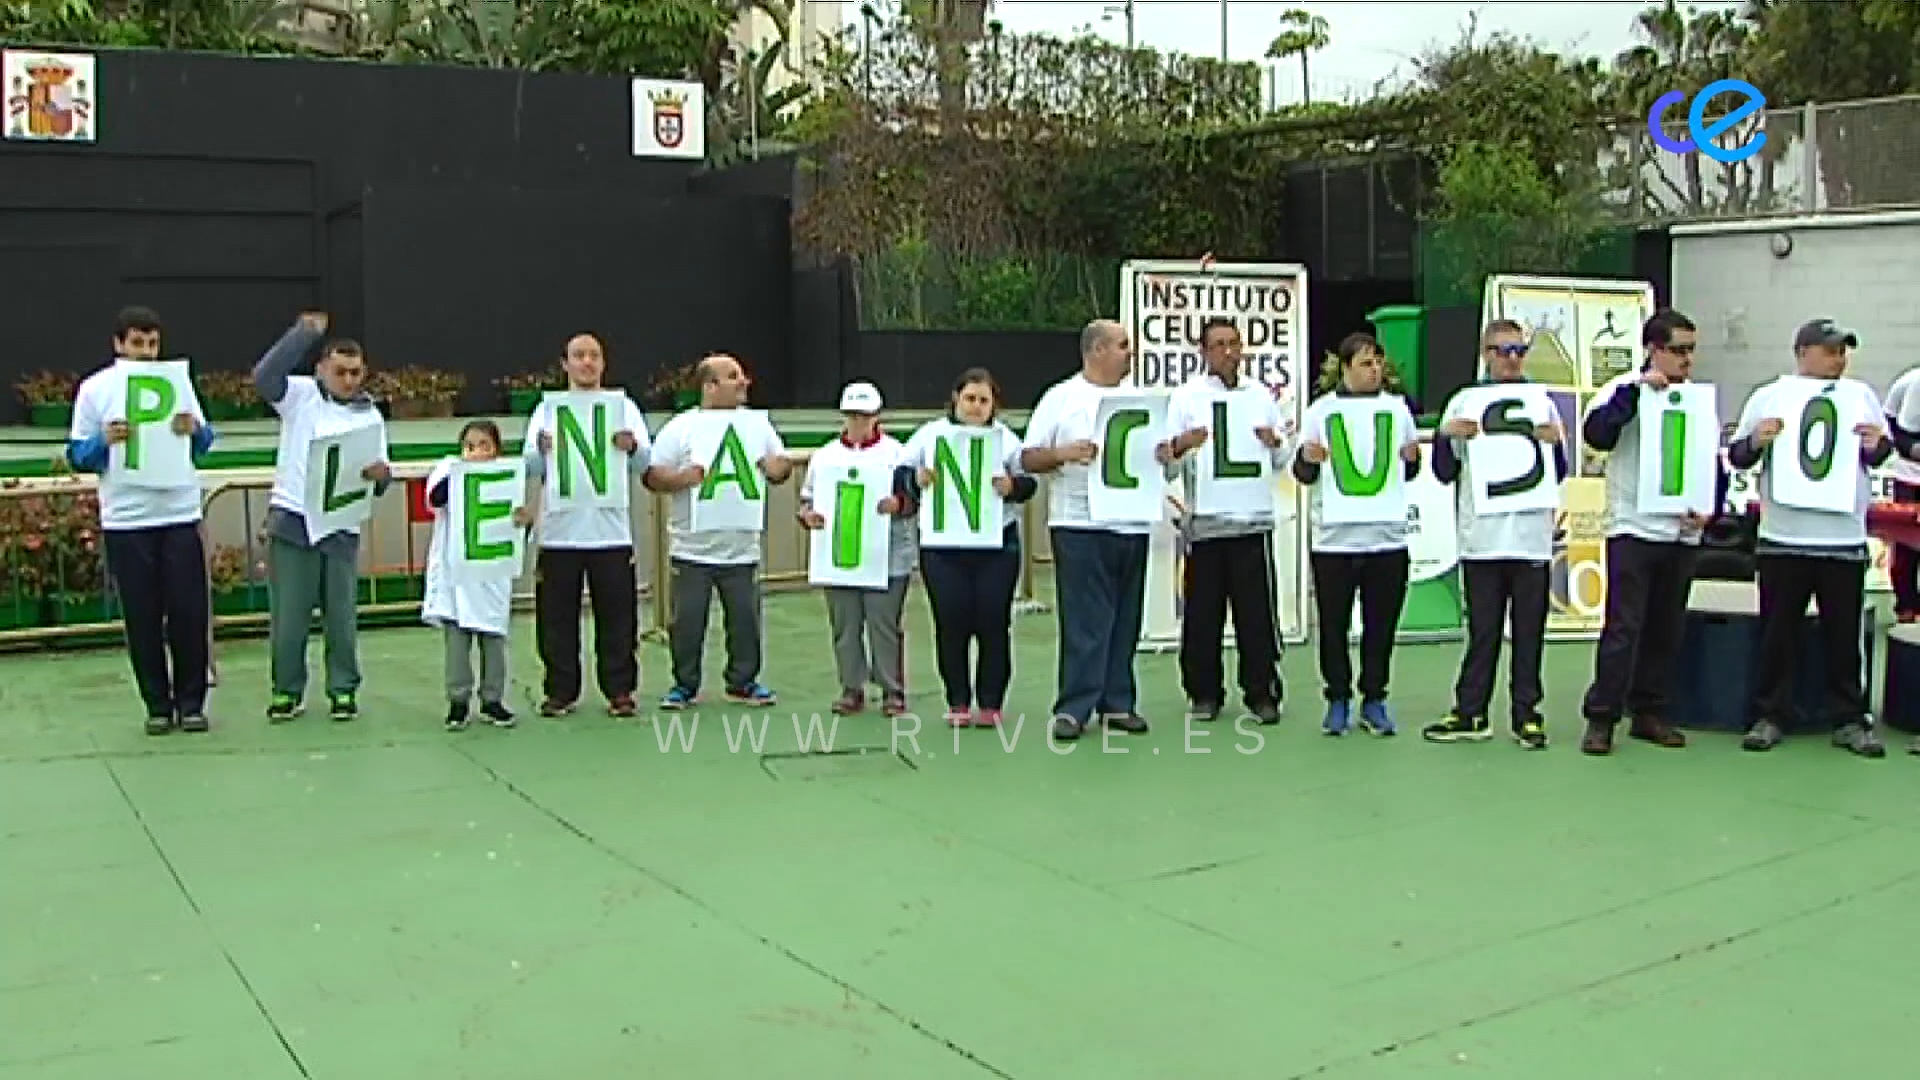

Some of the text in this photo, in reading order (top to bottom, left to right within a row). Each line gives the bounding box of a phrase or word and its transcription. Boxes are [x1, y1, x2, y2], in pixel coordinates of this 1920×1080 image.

[1143, 281, 1292, 313] INSTITUTO
[1247, 317, 1289, 347] DE
[1143, 351, 1290, 387] DEPTES
[126, 375, 176, 470] P
[556, 403, 607, 497] N
[698, 423, 761, 500] A
[1103, 409, 1150, 489] C
[1213, 401, 1262, 479] L
[1327, 411, 1393, 496] U
[1482, 398, 1543, 496] S
[322, 444, 367, 513] L
[463, 470, 516, 560] E
[932, 436, 982, 533] N
